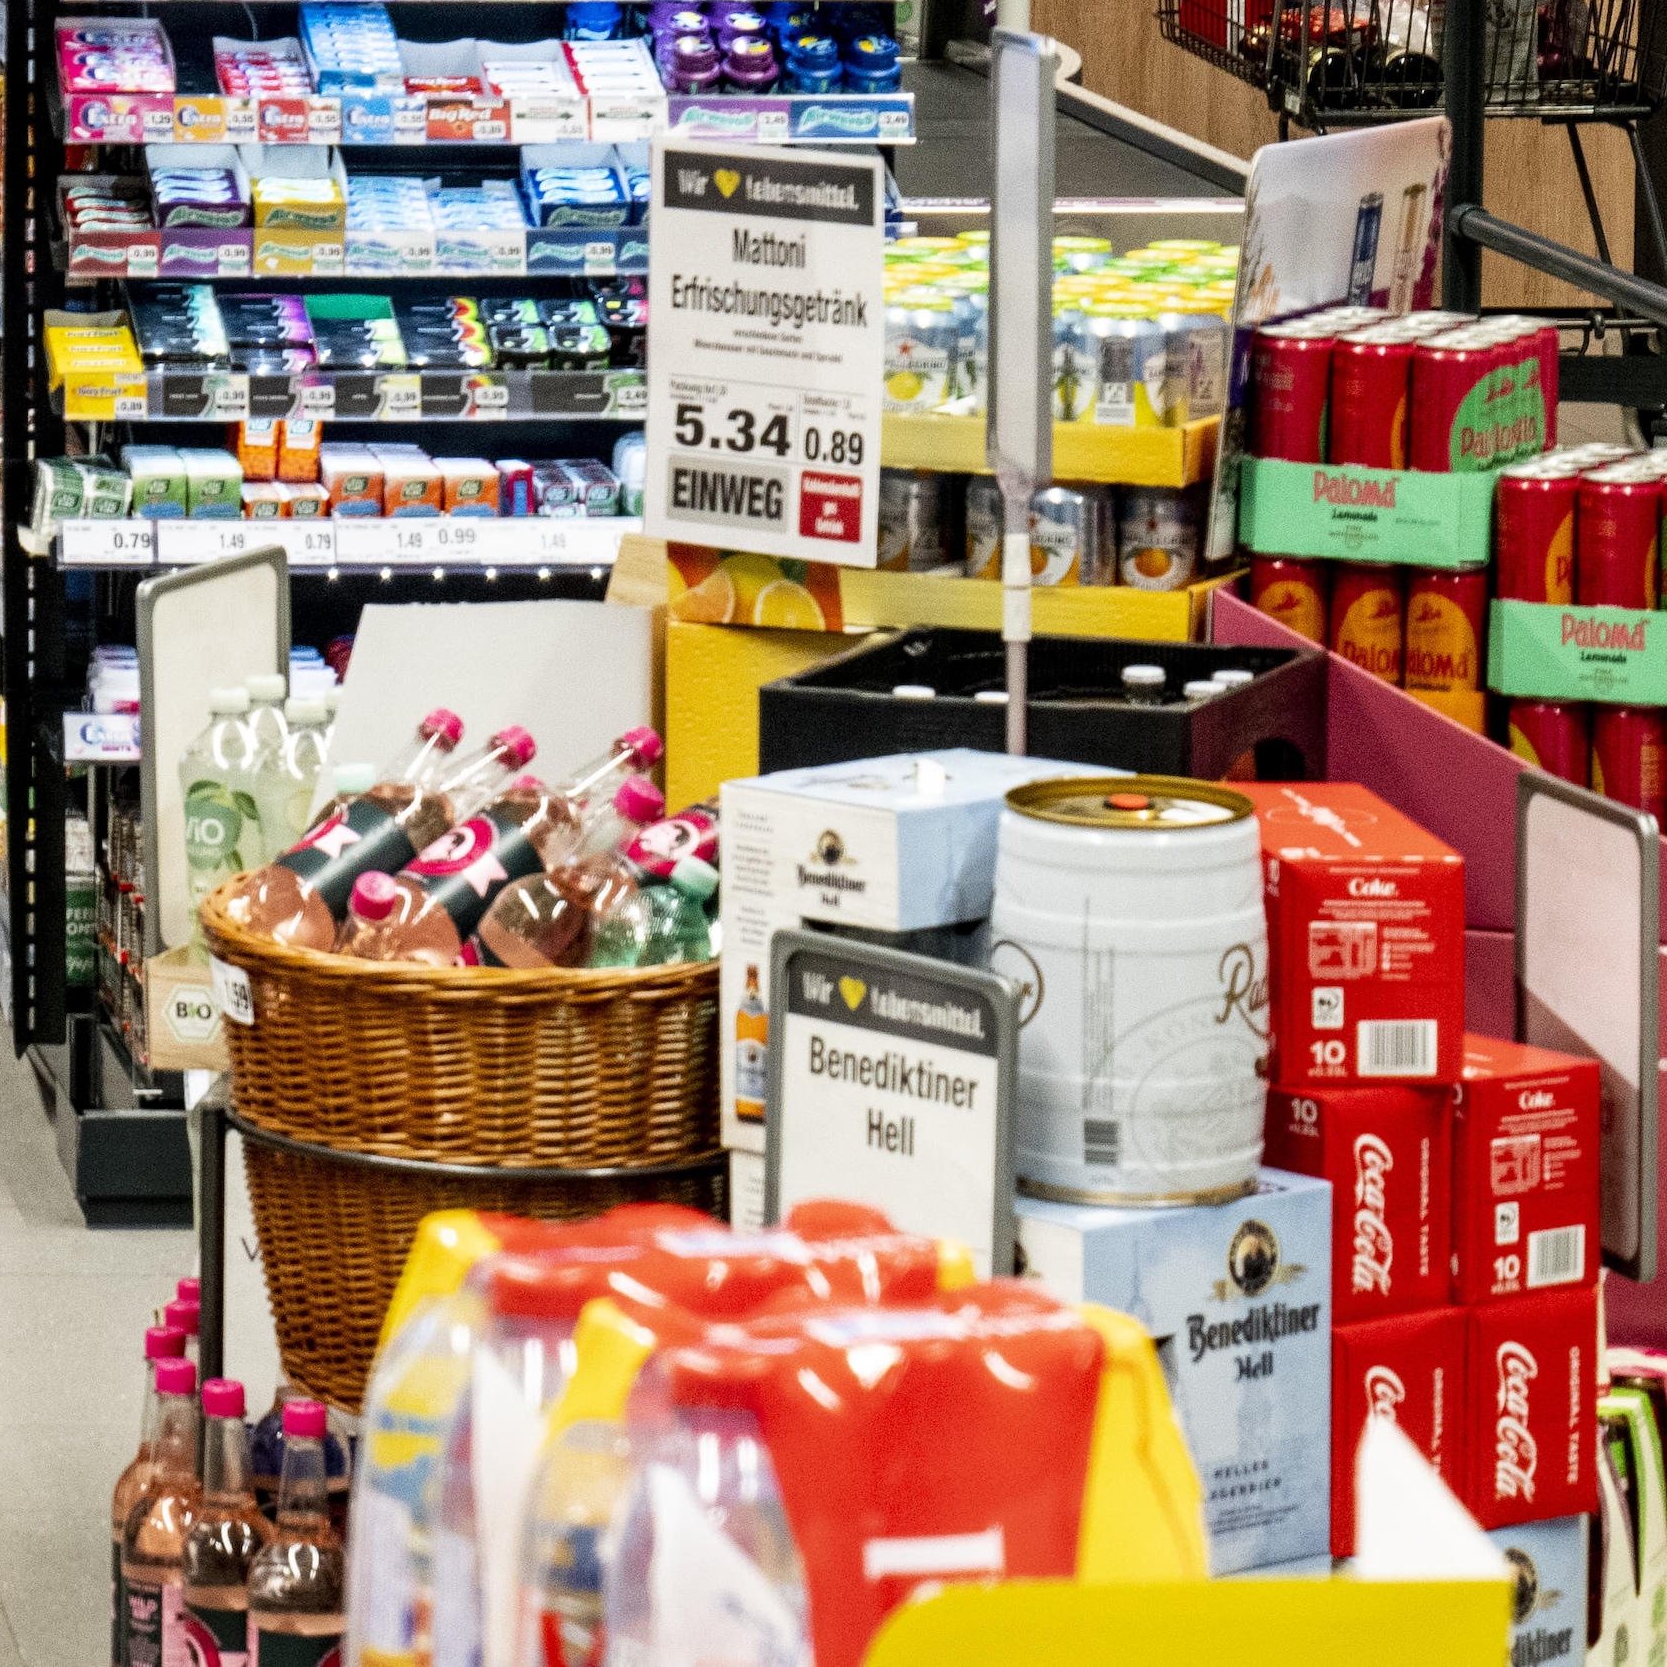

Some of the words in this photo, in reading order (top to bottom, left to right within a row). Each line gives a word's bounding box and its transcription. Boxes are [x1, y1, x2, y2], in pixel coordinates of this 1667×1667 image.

[732, 228, 807, 269] Mattoni
[670, 273, 869, 330] Erfrischungsgetränk
[675, 402, 791, 457] 5.34
[805, 426, 864, 466] 0.89
[673, 468, 784, 520] EINWEG
[1313, 470, 1397, 509] Paloma
[113, 532, 151, 551] 0.79
[220, 533, 245, 550] 1.49
[304, 533, 332, 551] 0.79
[397, 533, 423, 550] 1.49
[438, 527, 476, 545] 0.99
[1561, 613, 1647, 652] Paloma
[1310, 1040, 1347, 1065] 10
[809, 1035, 978, 1110] Benediktiner
[1291, 1098, 1319, 1124] 10
[867, 1107, 915, 1157] Hell
[1492, 1253, 1522, 1282] 10
[1185, 1302, 1321, 1364] Benediktiner
[1234, 1350, 1275, 1382] Hell
